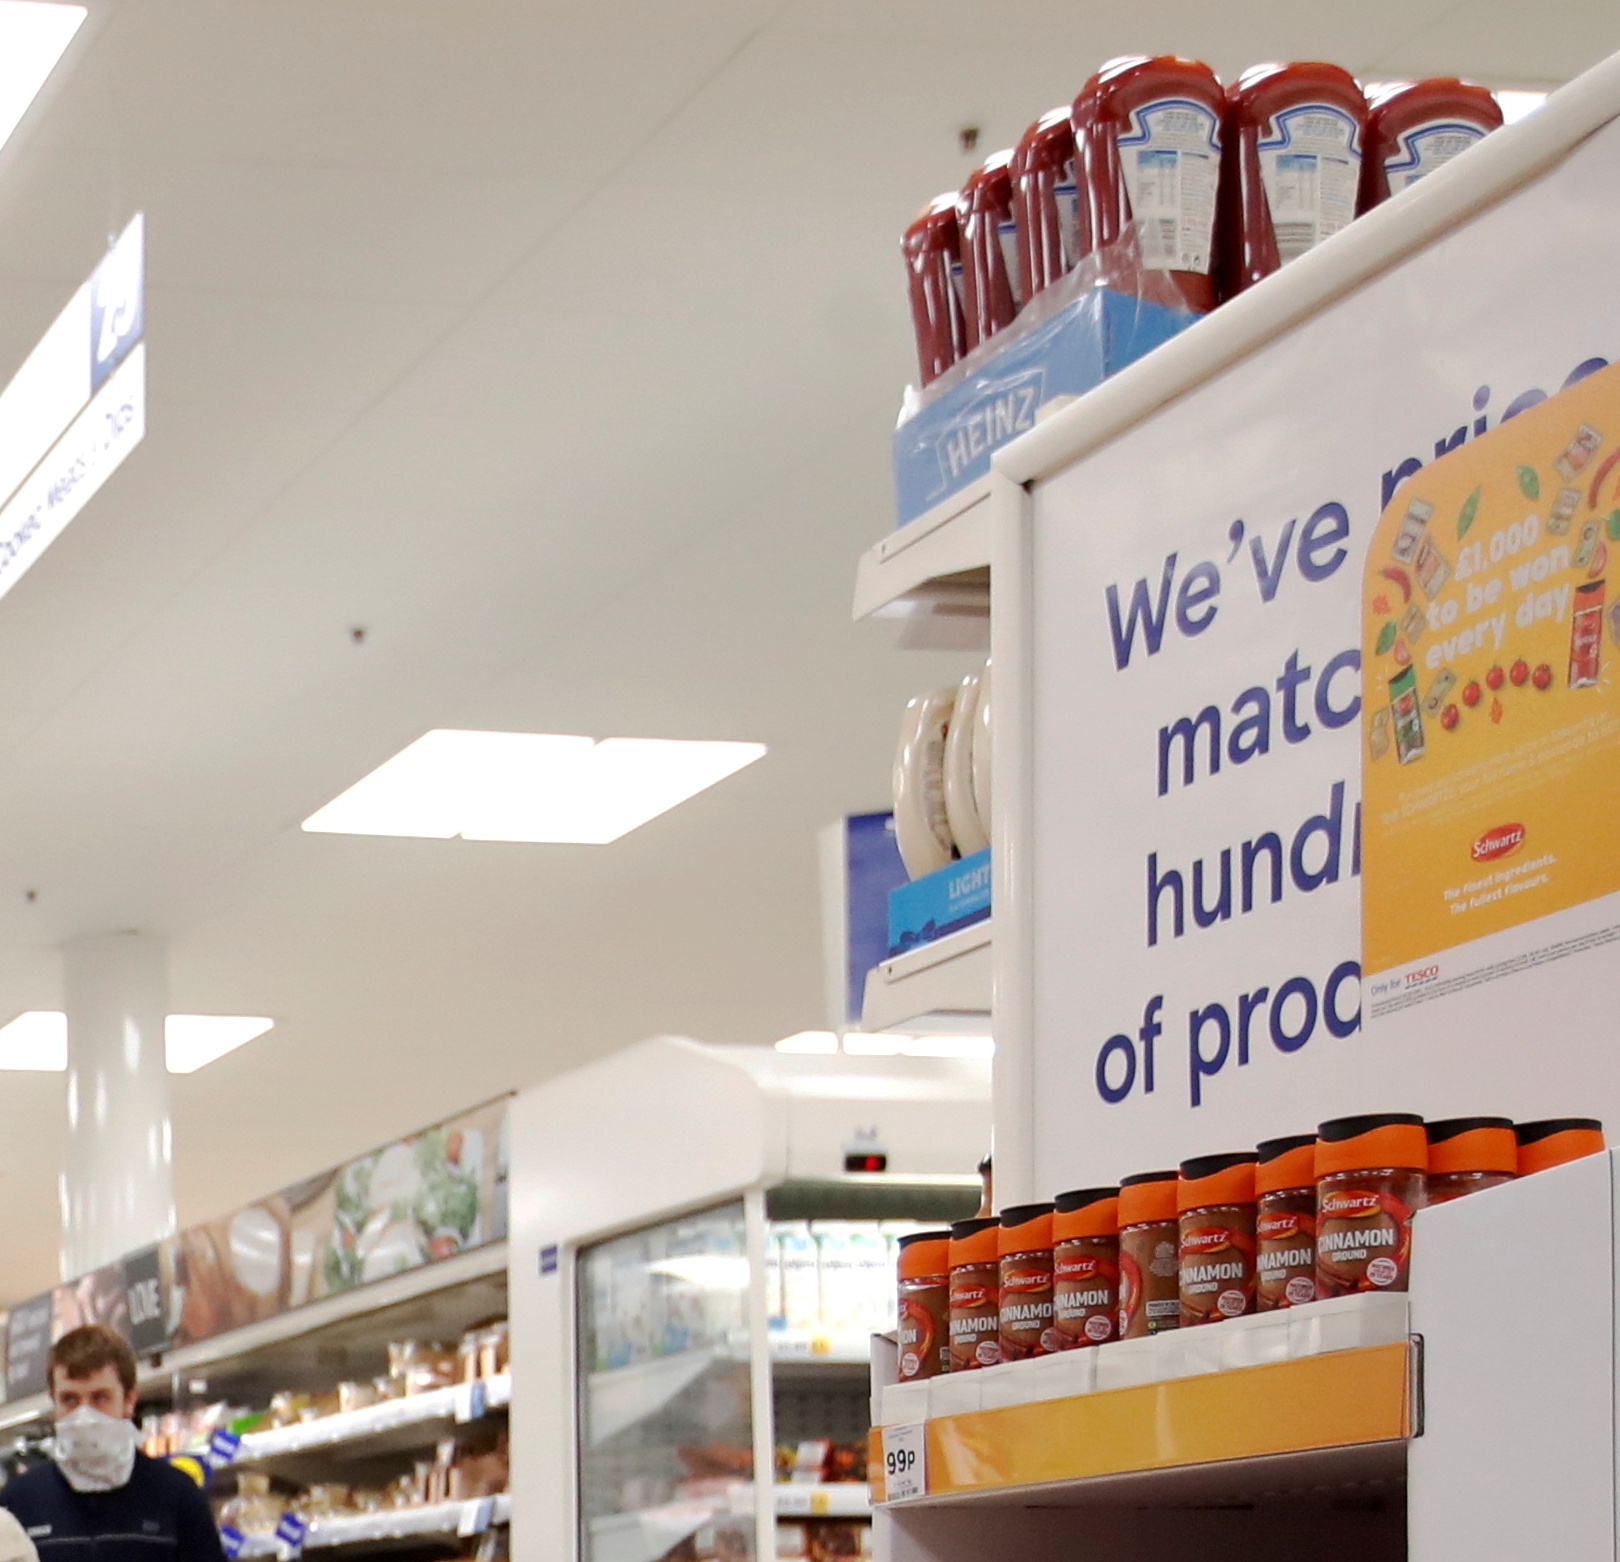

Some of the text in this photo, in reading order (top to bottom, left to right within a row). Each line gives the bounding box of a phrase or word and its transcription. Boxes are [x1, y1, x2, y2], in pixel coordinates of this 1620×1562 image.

[948, 388, 1034, 477] HEINZ
[1426, 545, 1570, 631] to be won
[1425, 582, 1570, 669] every day
[1159, 650, 1361, 796] matc
[1473, 829, 1523, 858] Schwartz
[1148, 781, 1361, 947] hund
[1404, 965, 1439, 984] TESCO
[1096, 997, 1164, 1104] of
[1322, 1195, 1379, 1213] Schwartz
[1181, 1231, 1228, 1249] Schwartz
[1318, 1229, 1394, 1252] CINNAMON
[1332, 1249, 1367, 1263] GROUND
[1003, 1273, 1049, 1288] Schwartz
[886, 1448, 916, 1476] 99p
